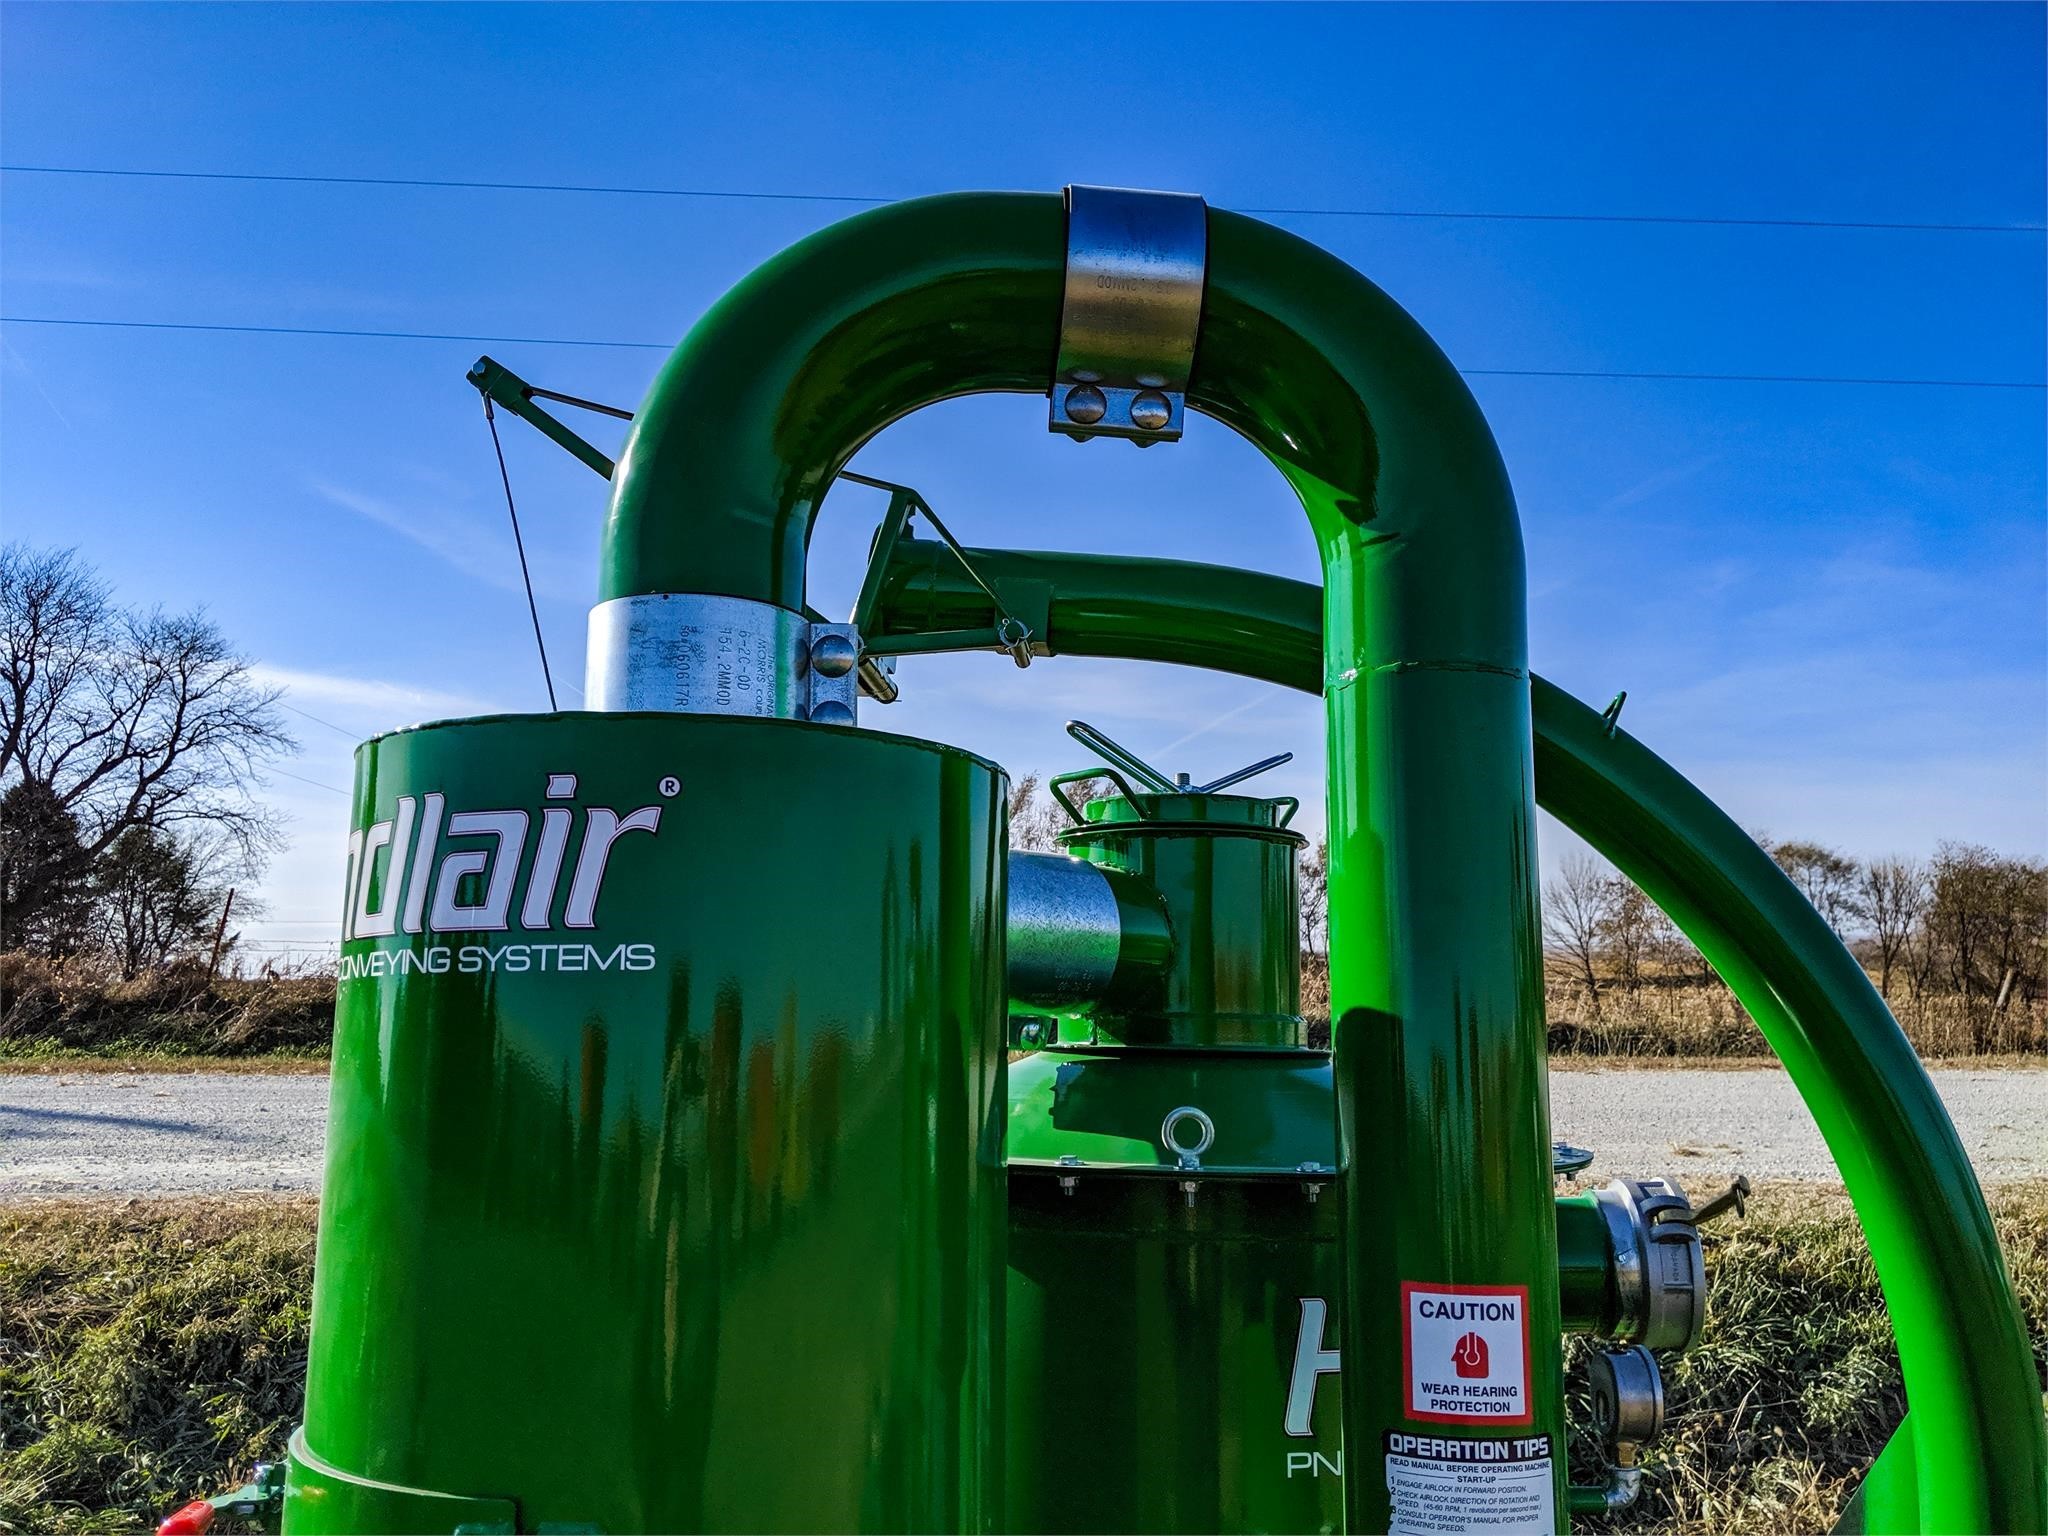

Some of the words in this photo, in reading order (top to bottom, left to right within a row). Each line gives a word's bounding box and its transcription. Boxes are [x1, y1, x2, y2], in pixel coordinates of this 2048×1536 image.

[756, 638, 767, 684] MORRIS
[458, 943, 656, 972] SYSTEMS
[1419, 1300, 1515, 1321] CAUTION
[1421, 1382, 1460, 1396] WEAR
[1463, 1384, 1518, 1398] HEARING
[1431, 1399, 1511, 1413] PROTECTION
[1390, 1433, 1509, 1460] OPERATION
[1513, 1437, 1549, 1458] TIPS
[1390, 1457, 1410, 1467] READ
[1411, 1461, 1444, 1471] MANUAL
[1446, 1464, 1479, 1473] BEFORE
[1481, 1464, 1524, 1474] OPERATING
[1524, 1461, 1550, 1471] MACHINE
[1391, 1476, 1395, 1485] 1
[1396, 1479, 1423, 1489] ENGAGE
[1424, 1484, 1454, 1493] AIRLOCK
[1457, 1476, 1497, 1484] START-UP
[1390, 1487, 1396, 1495] 2
[1396, 1490, 1418, 1499] CHECK
[1420, 1494, 1450, 1503] AIRLOCK
[1450, 1497, 1487, 1505] DIRECTION
[1488, 1497, 1498, 1505] OF
[1499, 1496, 1529, 1505] ROTATION
[1529, 1494, 1541, 1502] AND
[1397, 1508, 1427, 1519] CONSULT
[1428, 1513, 1472, 1524] OPERATOR'S
[1473, 1516, 1501, 1524] MANUAL
[1517, 1514, 1539, 1523] PROPER
[1498, 1507, 1509, 1515] per
[1397, 1517, 1435, 1530] OPERATING
